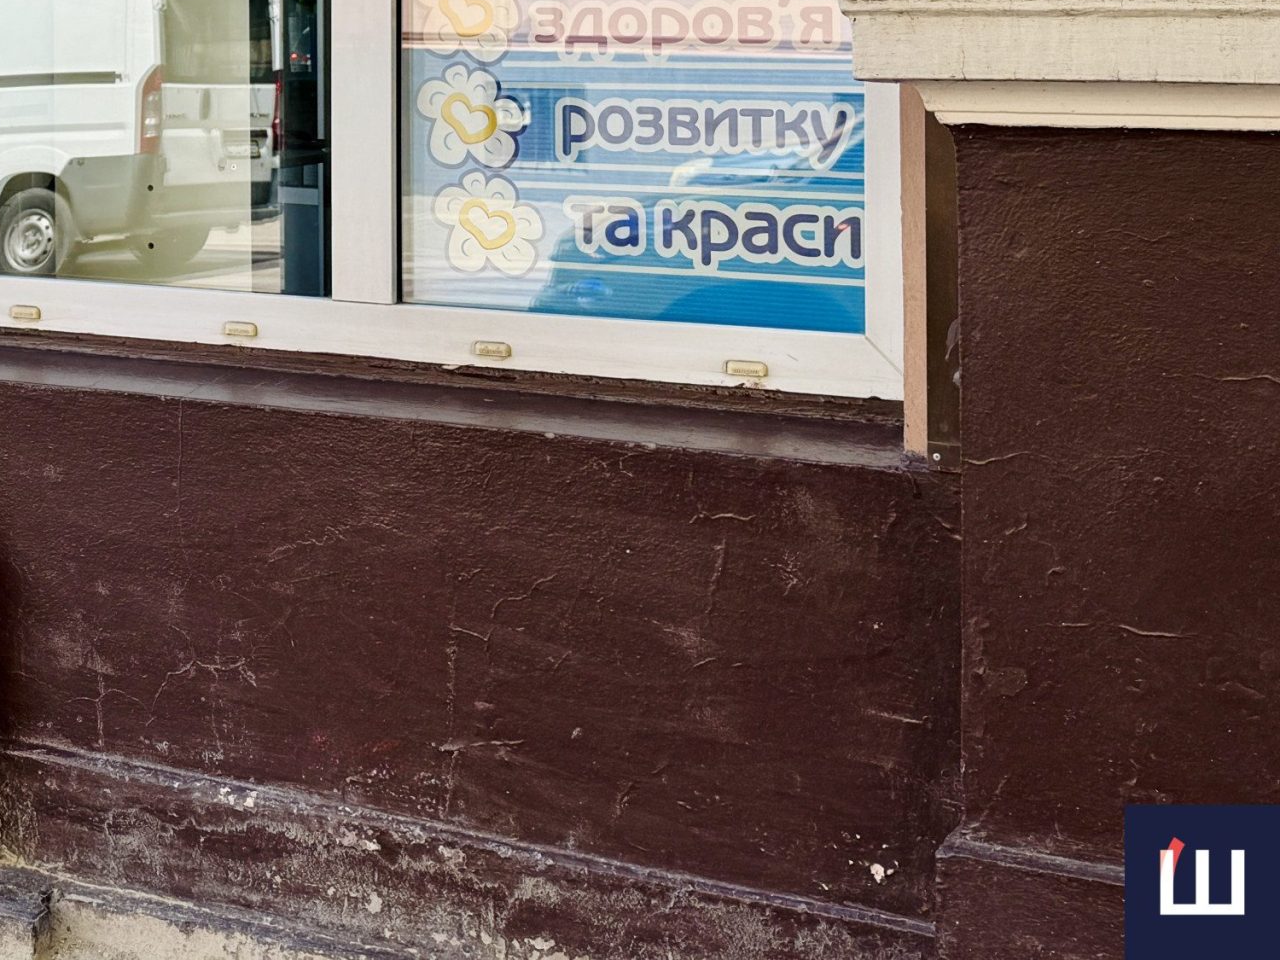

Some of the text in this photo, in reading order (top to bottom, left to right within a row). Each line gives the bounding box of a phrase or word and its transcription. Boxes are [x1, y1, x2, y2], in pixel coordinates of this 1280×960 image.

[562, 104, 849, 163] розвитку
[570, 203, 862, 267] та краси
